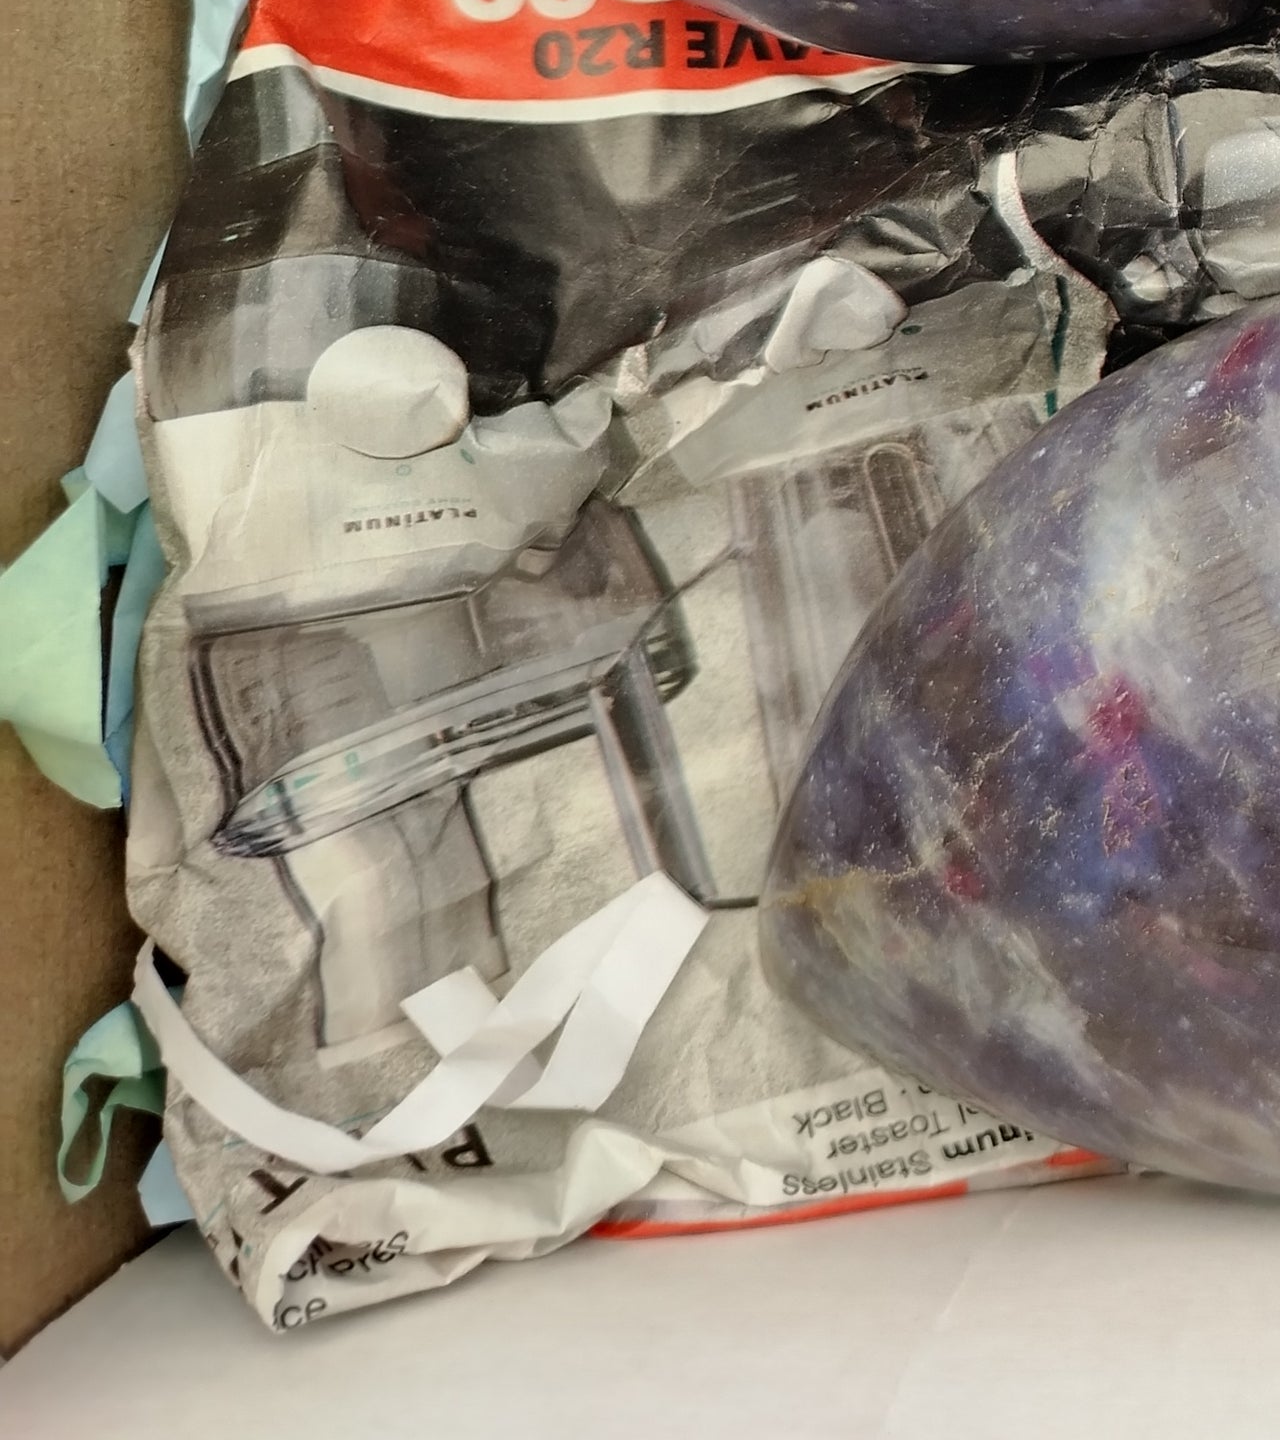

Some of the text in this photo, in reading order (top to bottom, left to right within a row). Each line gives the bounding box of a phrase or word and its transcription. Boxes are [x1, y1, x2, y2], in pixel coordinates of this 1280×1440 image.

[532, 19, 667, 82] R20
[791, 1086, 890, 1139] Black
[825, 1110, 950, 1161] Toaster
[781, 1148, 934, 1196] Stainless
